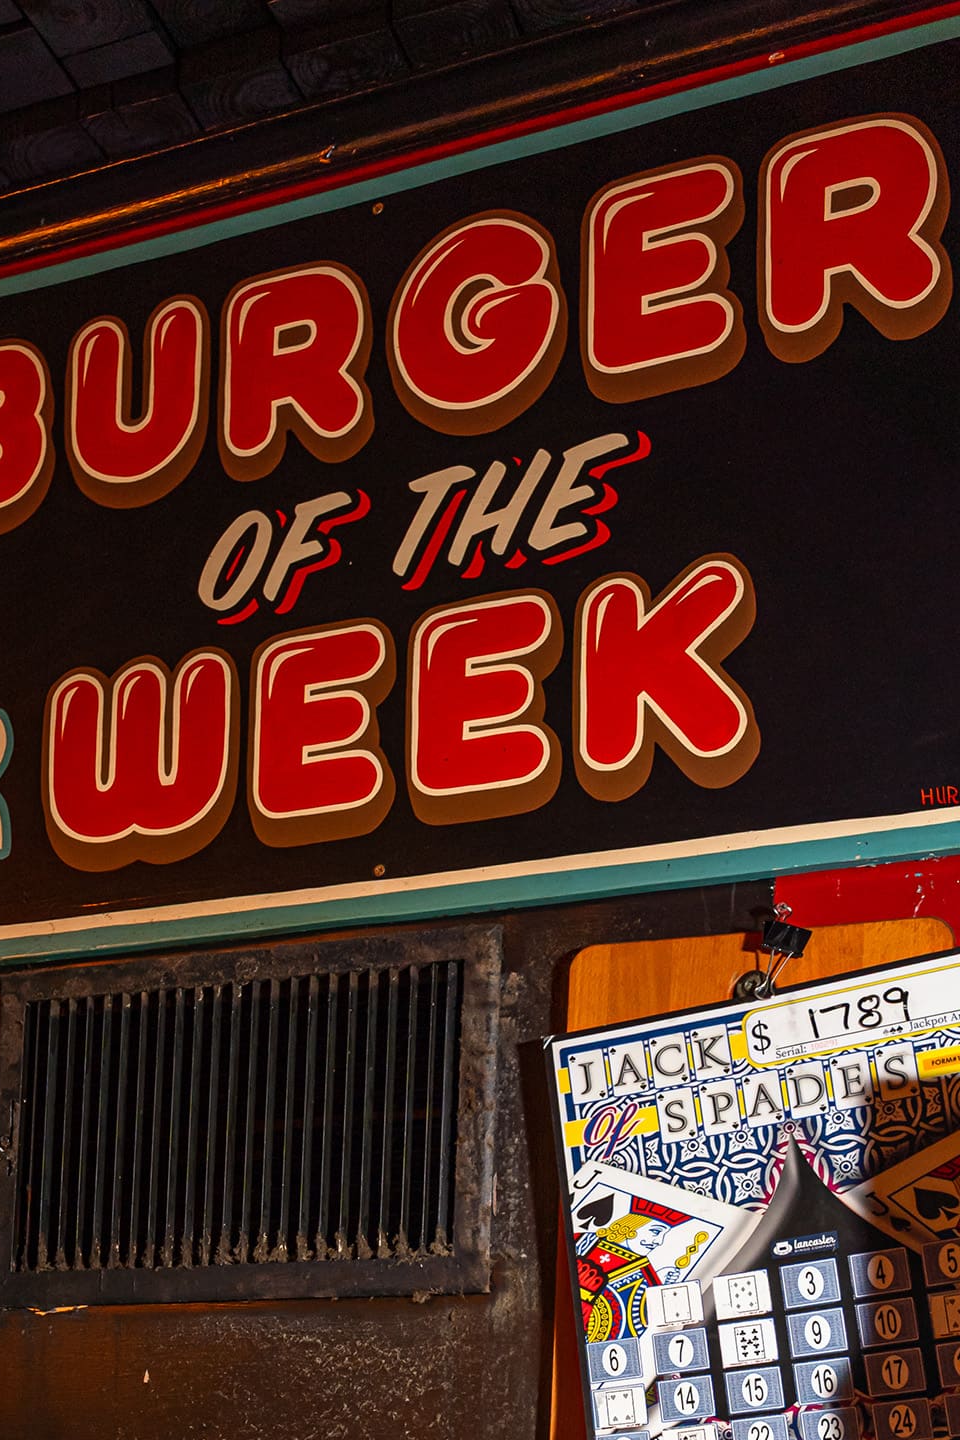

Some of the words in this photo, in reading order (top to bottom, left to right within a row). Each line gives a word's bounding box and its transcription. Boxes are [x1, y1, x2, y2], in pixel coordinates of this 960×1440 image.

[198, 487, 369, 625] OF
[393, 431, 652, 590] THE
[46, 557, 756, 866] WEEK
[751, 1020, 772, 1055] $
[808, 986, 911, 1039] 1789
[908, 1014, 948, 1032] Jackpot
[578, 1032, 730, 1097] JACK
[775, 1045, 807, 1059] Serial:
[583, 1102, 640, 1159] Of
[664, 1053, 908, 1136] SPADES
[793, 1234, 837, 1250] lancaster
[876, 1259, 886, 1284] 4
[946, 1248, 958, 1274] 5
[806, 1272, 817, 1296] 3
[812, 1320, 823, 1345] 9
[877, 1308, 897, 1335] 10
[609, 1348, 619, 1372] 6
[675, 1339, 684, 1363] 7
[814, 1368, 834, 1393] 16
[884, 1358, 903, 1385] 17
[677, 1385, 695, 1411] 14
[744, 1377, 764, 1402] 15
[891, 1407, 913, 1434] 24
